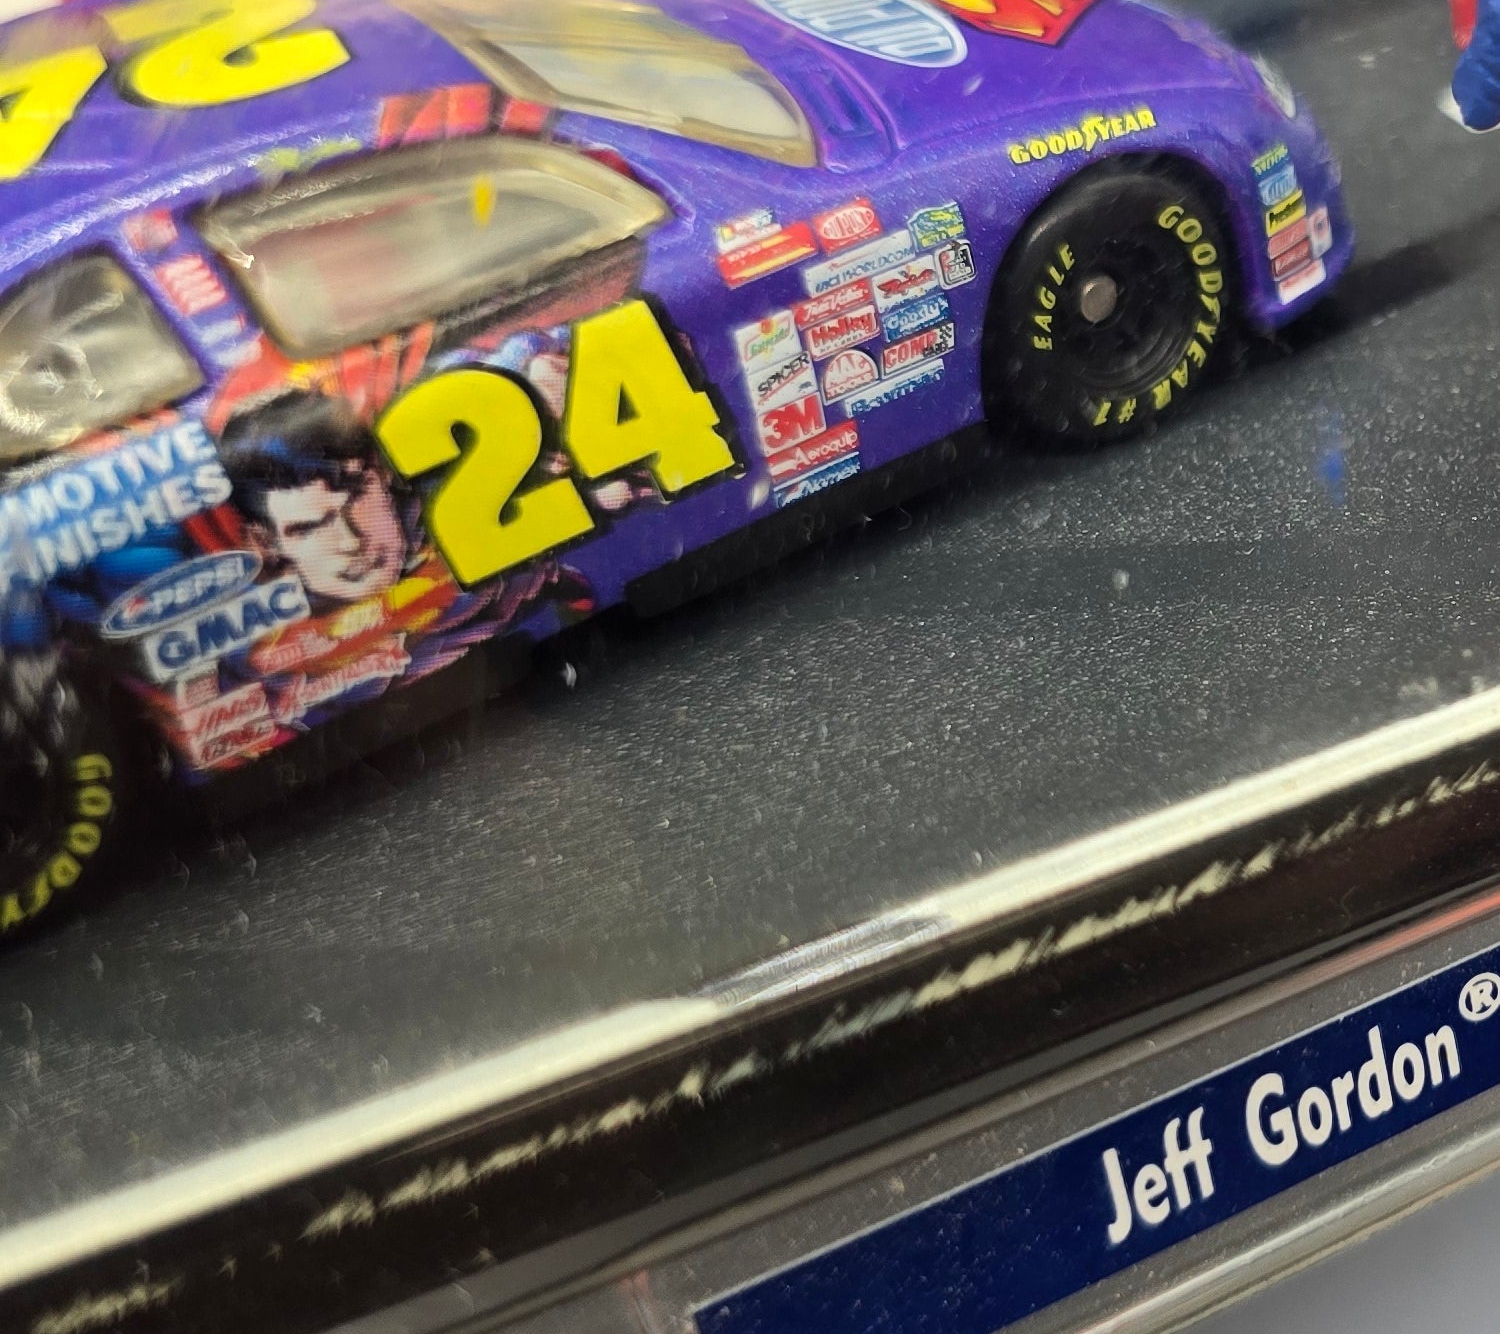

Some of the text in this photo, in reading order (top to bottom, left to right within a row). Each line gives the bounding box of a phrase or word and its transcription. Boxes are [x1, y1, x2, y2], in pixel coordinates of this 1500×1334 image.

[1007, 108, 1157, 165] GOODYEAR
[1033, 243, 1076, 351] EAGLE
[1158, 205, 1224, 411] GOODYEAR
[757, 352, 811, 398] SPICER
[763, 394, 826, 449] 3M
[0, 418, 217, 539] MOTIVE
[376, 299, 735, 585] 24
[794, 430, 859, 466] Aeroquip
[0, 462, 234, 593] INISHES
[157, 581, 302, 668] GMAC
[1102, 1107, 1214, 1245] Jeff
